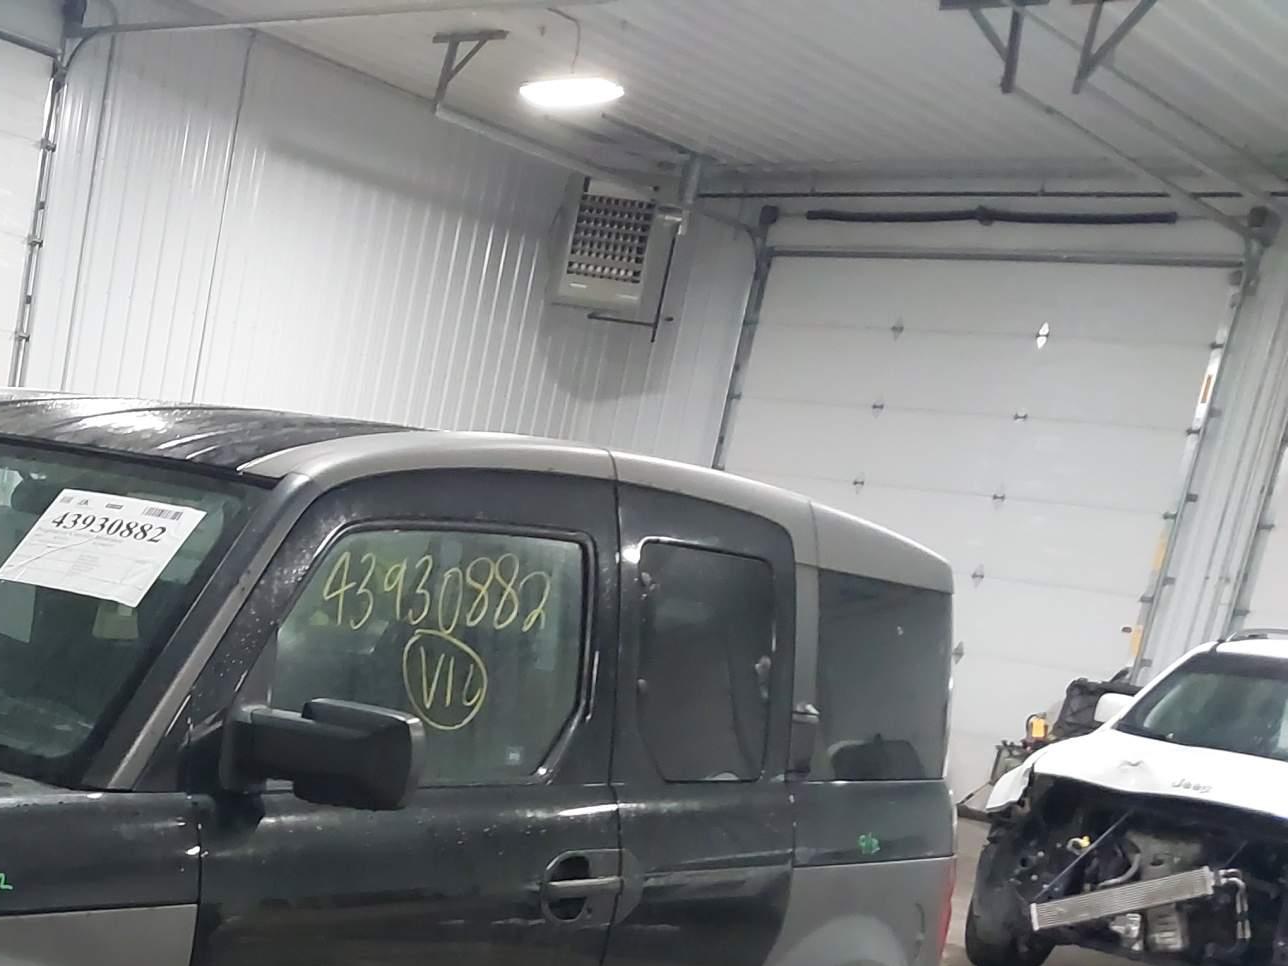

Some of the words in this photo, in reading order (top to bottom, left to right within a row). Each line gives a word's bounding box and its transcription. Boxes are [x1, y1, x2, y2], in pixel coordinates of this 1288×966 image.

[50, 511, 167, 543] 43930882
[322, 551, 551, 634] 43930882
[1170, 777, 1214, 794] Jeep
